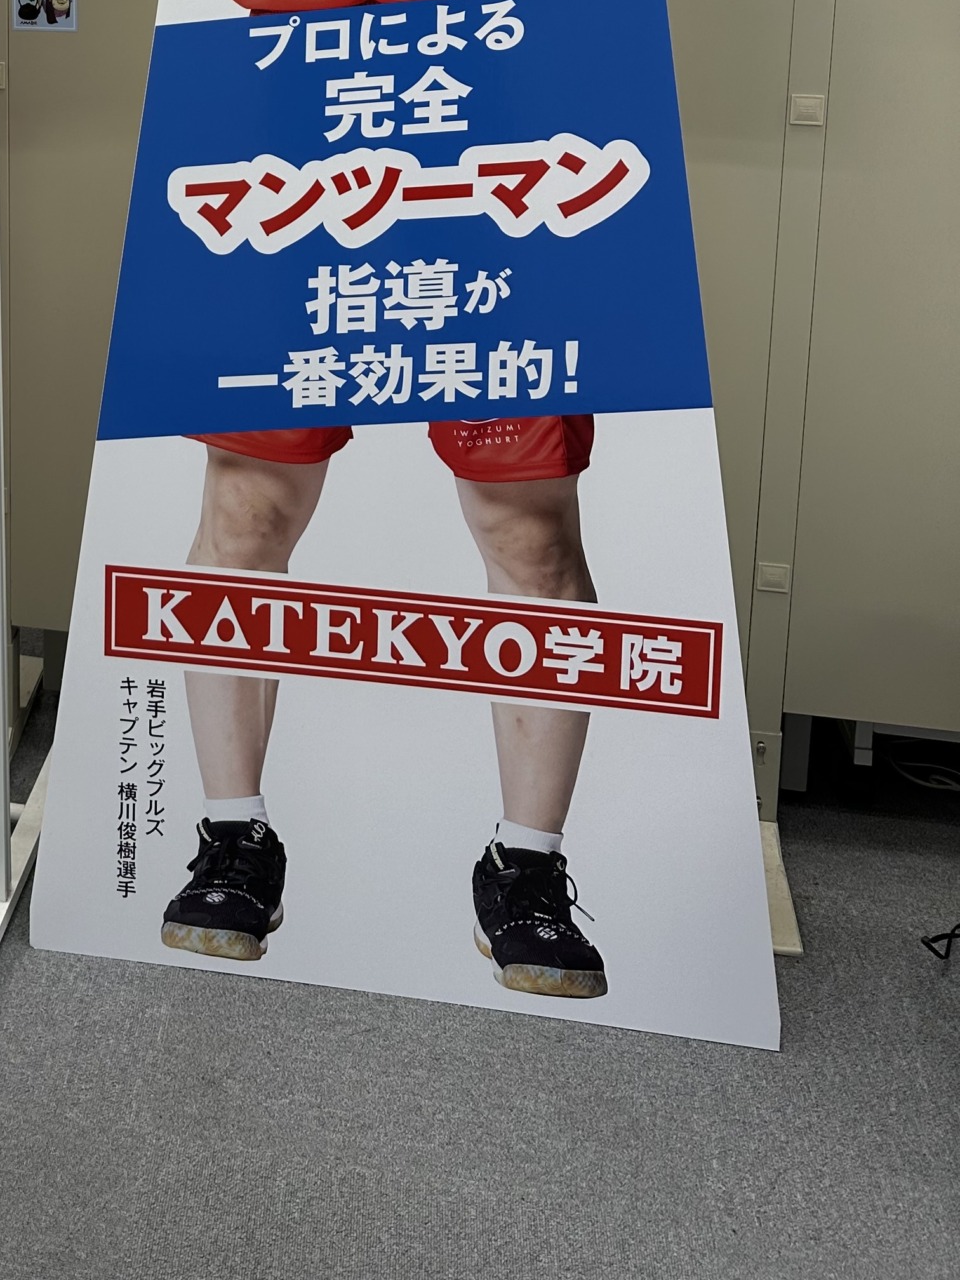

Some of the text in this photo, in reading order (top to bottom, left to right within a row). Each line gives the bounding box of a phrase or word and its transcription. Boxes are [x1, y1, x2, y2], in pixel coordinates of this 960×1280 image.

[248, 0, 525, 71] プロによる
[323, 66, 473, 142] 完全
[185, 151, 630, 237] マンツーマン
[306, 259, 512, 334] 指導が
[218, 340, 580, 409] 一番効果的!
[453, 424, 521, 437] IWAIZUMI
[457, 435, 519, 447] YOGHURT
[141, 587, 683, 695] KATEKYO学院
[116, 677, 139, 898] キャプテン 横川俊樹選手
[145, 678, 166, 837] 岩手ビッグブルズ
